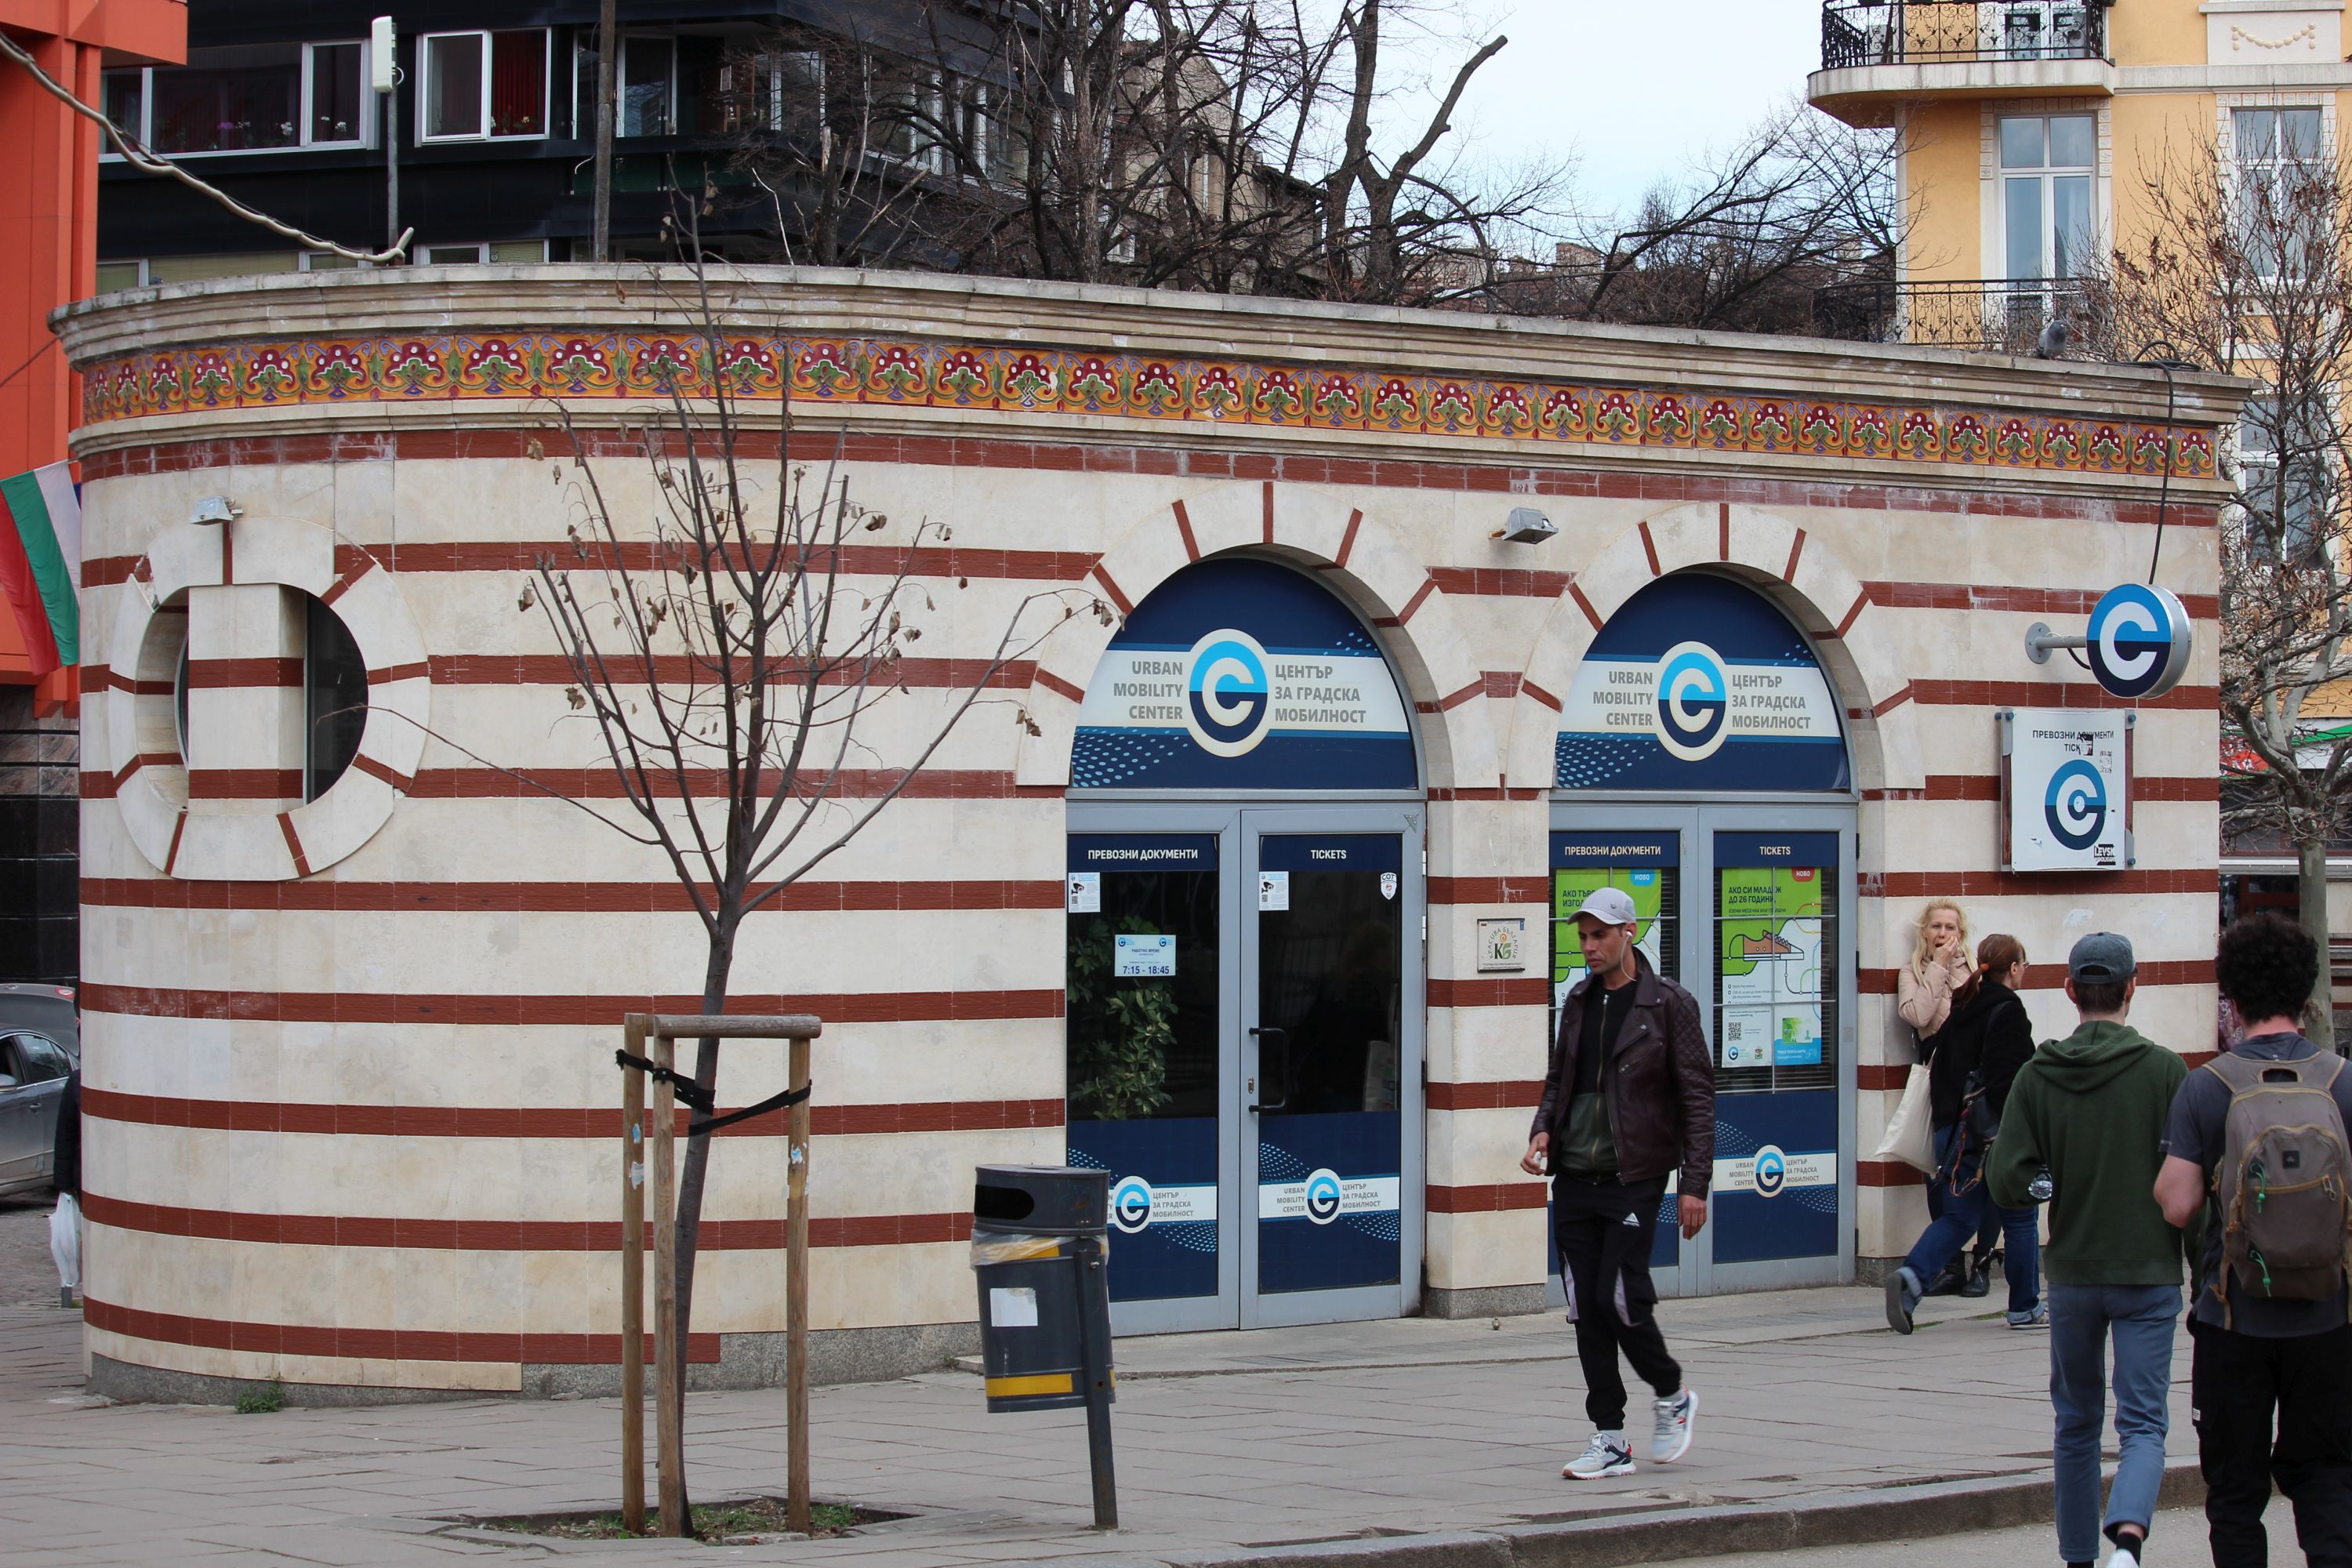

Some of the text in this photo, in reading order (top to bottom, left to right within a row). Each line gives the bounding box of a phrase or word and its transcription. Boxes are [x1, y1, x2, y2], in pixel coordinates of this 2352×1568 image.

[1131, 662, 1183, 676] URBAN
[1275, 664, 1333, 681] ЦЕНТЪР
[1609, 671, 1653, 684] URBAN
[1732, 674, 1782, 690] ЦЕНТЪР
[1113, 683, 1183, 698] MOBILITY
[1275, 687, 1360, 703] ЗА ГРАДСКА
[1593, 691, 1653, 706] MOBILITY
[1732, 695, 1806, 711] ЗА ГРАДСКА
[1129, 706, 1183, 720] CENTER
[1275, 708, 1367, 724] МОБИЛНОСТ
[1606, 713, 1653, 726] CENTER
[1732, 715, 1811, 729] МОБИЛНОСТ
[2032, 730, 2075, 739] ПРЕВОЗНИ
[1088, 849, 1198, 861] ПРЕВОЗНИ ДОКУМЕНТИ
[1311, 849, 1347, 859] TICKETS
[1565, 846, 1661, 856] ПРЕВОЗНИ ДОКУМЕНТИ
[1760, 846, 1791, 855] TICKETS
[1729, 895, 1737, 904] ДО
[1123, 966, 1140, 975] 7:15
[1148, 966, 1170, 975] 18:45
[1794, 1167, 1817, 1175] ГРАДСКА
[1351, 1192, 1378, 1200] ГРАДСКА
[1342, 1200, 1381, 1209] МОБИЛНОСТ
